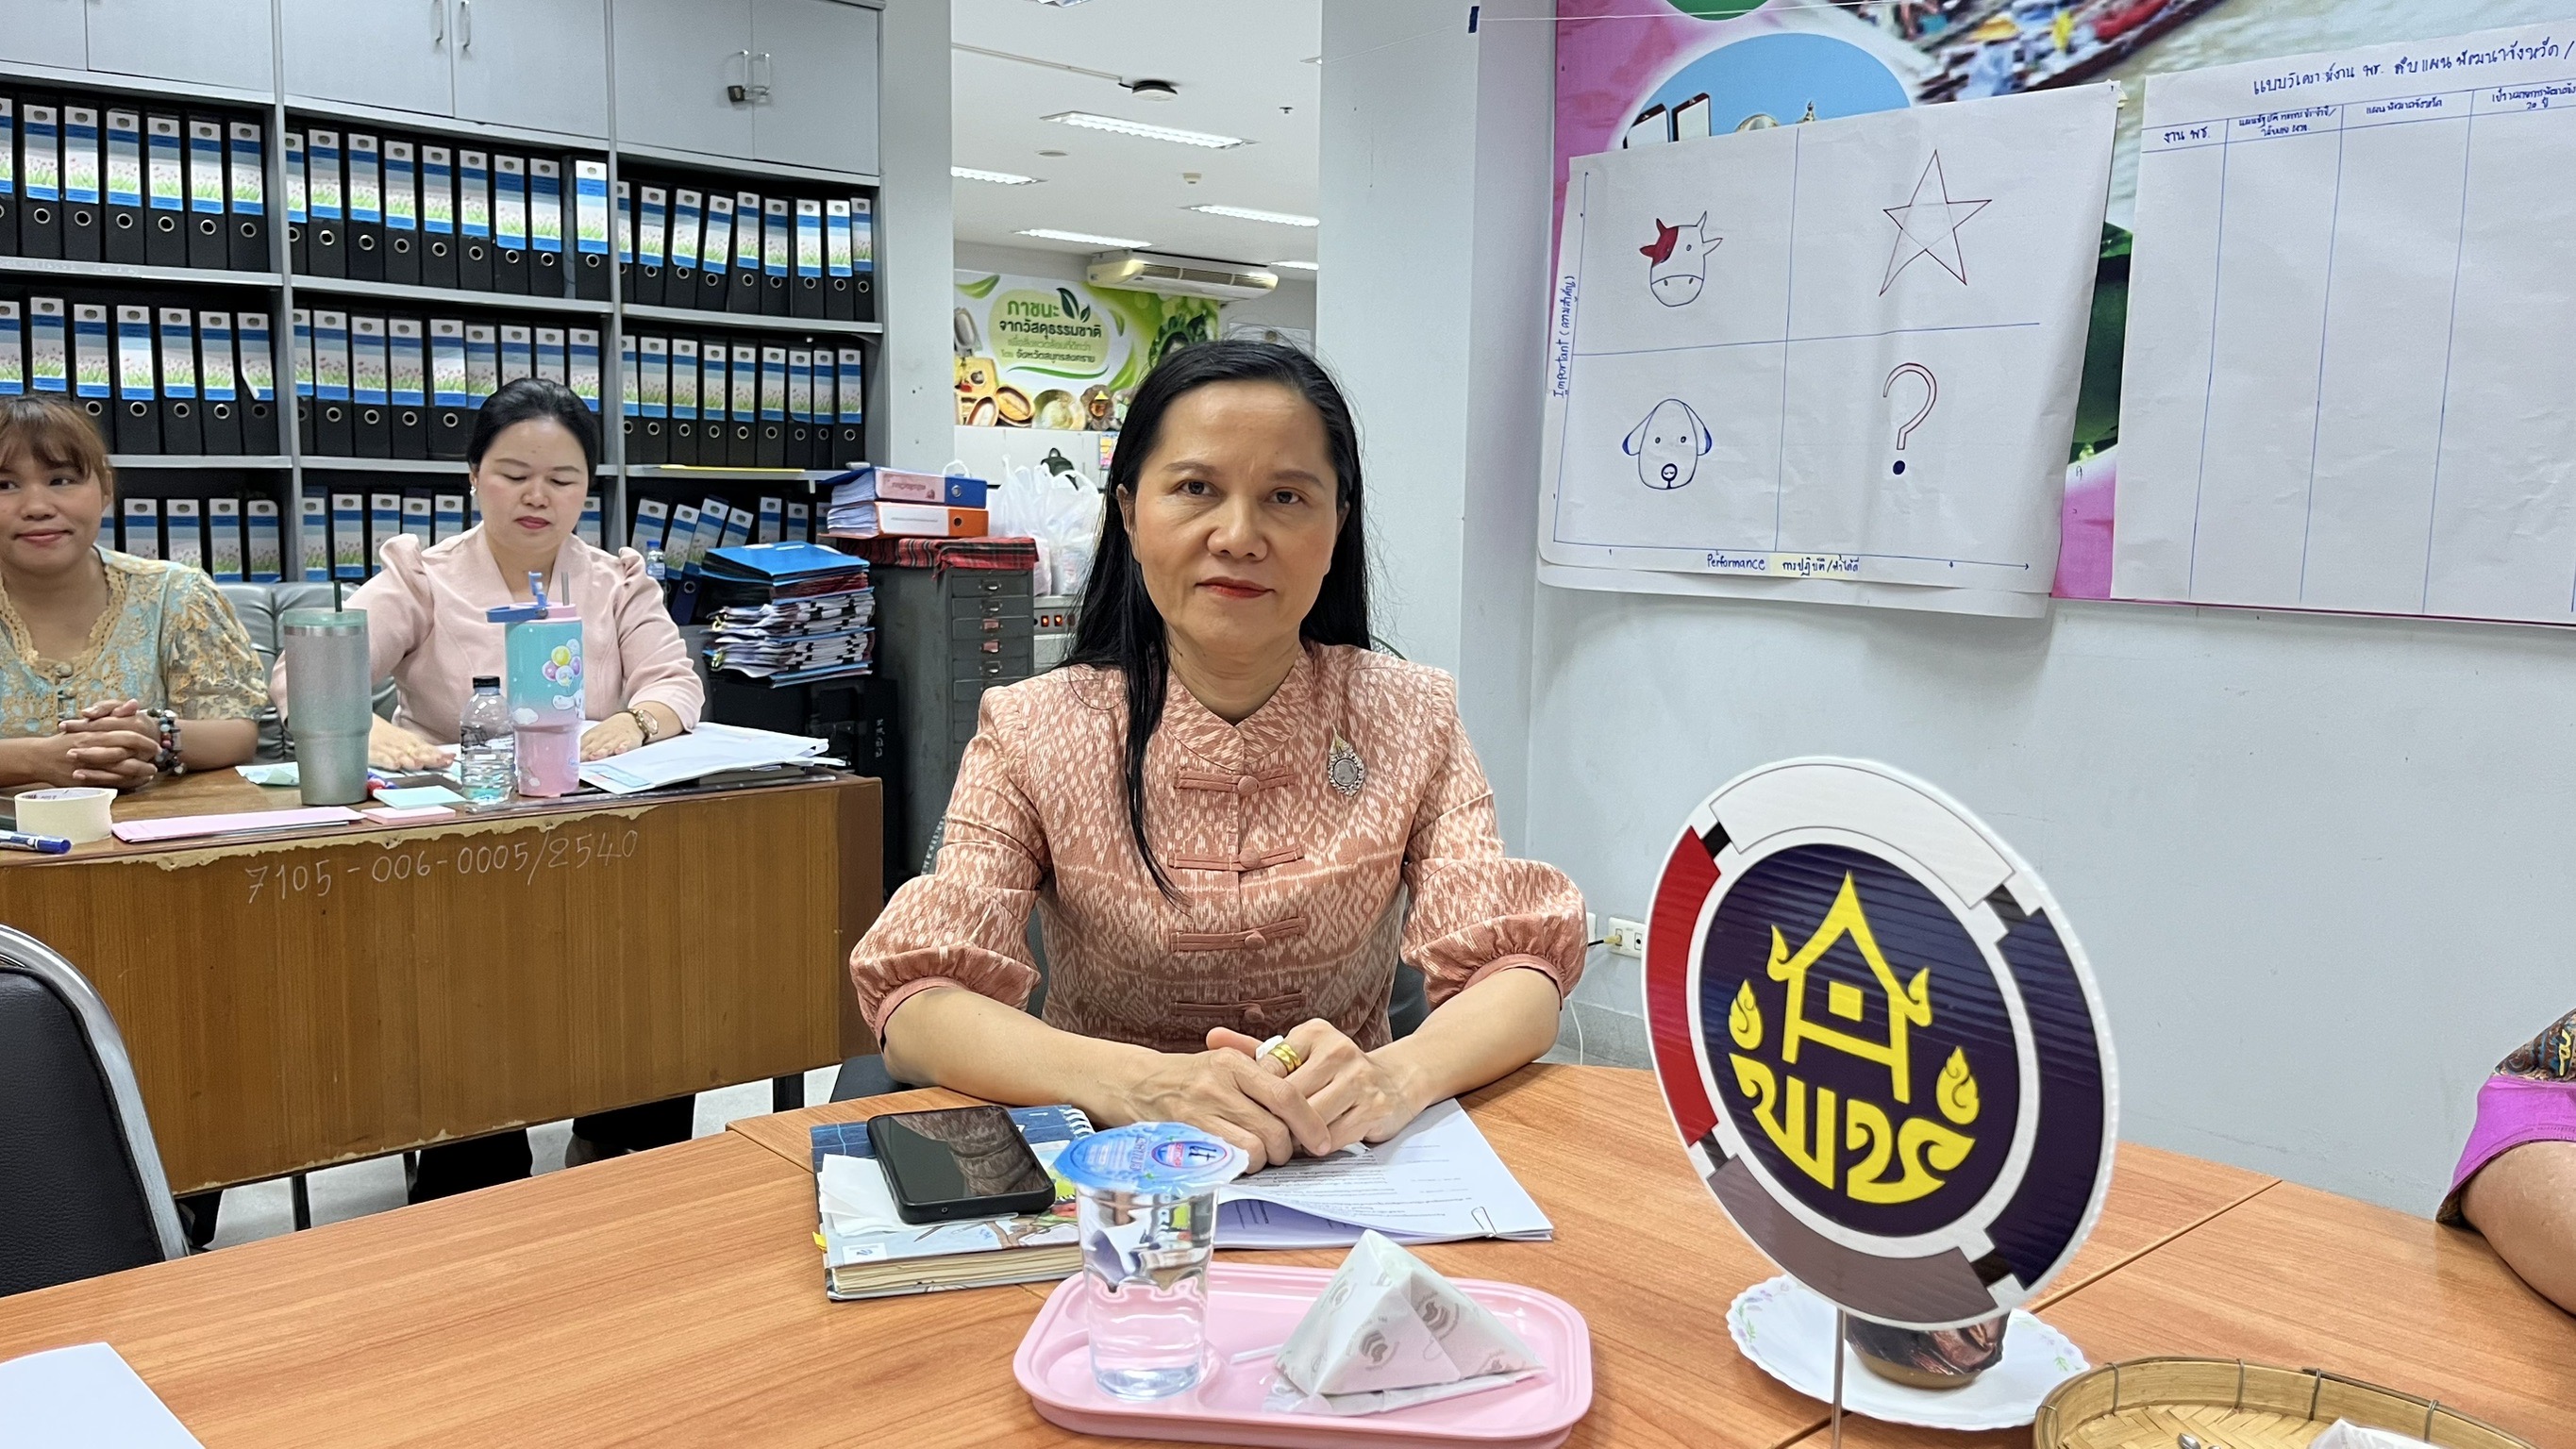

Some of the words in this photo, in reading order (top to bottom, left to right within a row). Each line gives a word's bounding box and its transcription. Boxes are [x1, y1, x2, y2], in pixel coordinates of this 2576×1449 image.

[998, 318, 1102, 340] จากวัสดุธรรมชาติ
[1552, 339, 1568, 399] Important
[1706, 553, 1766, 571] Performance
